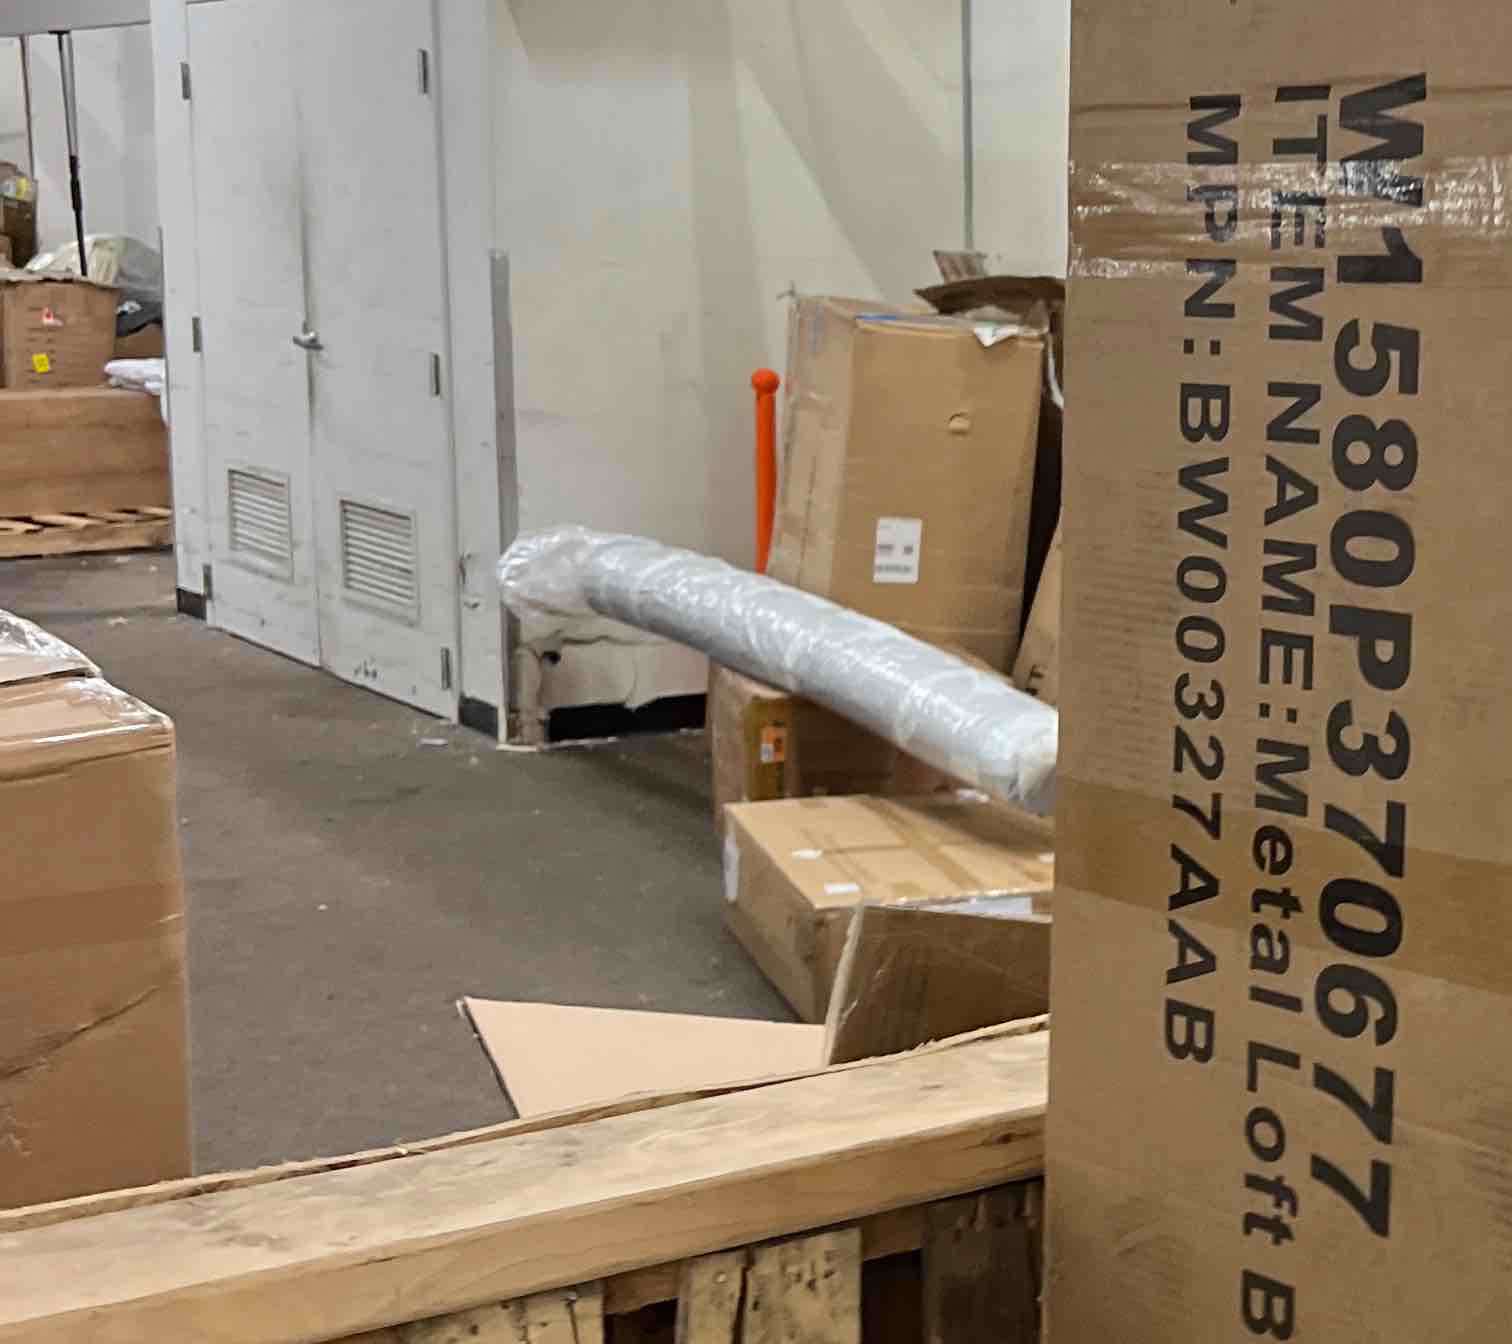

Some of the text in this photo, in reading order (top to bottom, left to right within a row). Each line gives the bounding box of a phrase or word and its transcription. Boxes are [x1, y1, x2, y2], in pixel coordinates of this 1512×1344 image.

[1268, 84, 1332, 342] ITEM
[1310, 72, 1428, 1239] W1580P370677
[1242, 1039, 1301, 1247] Loft
